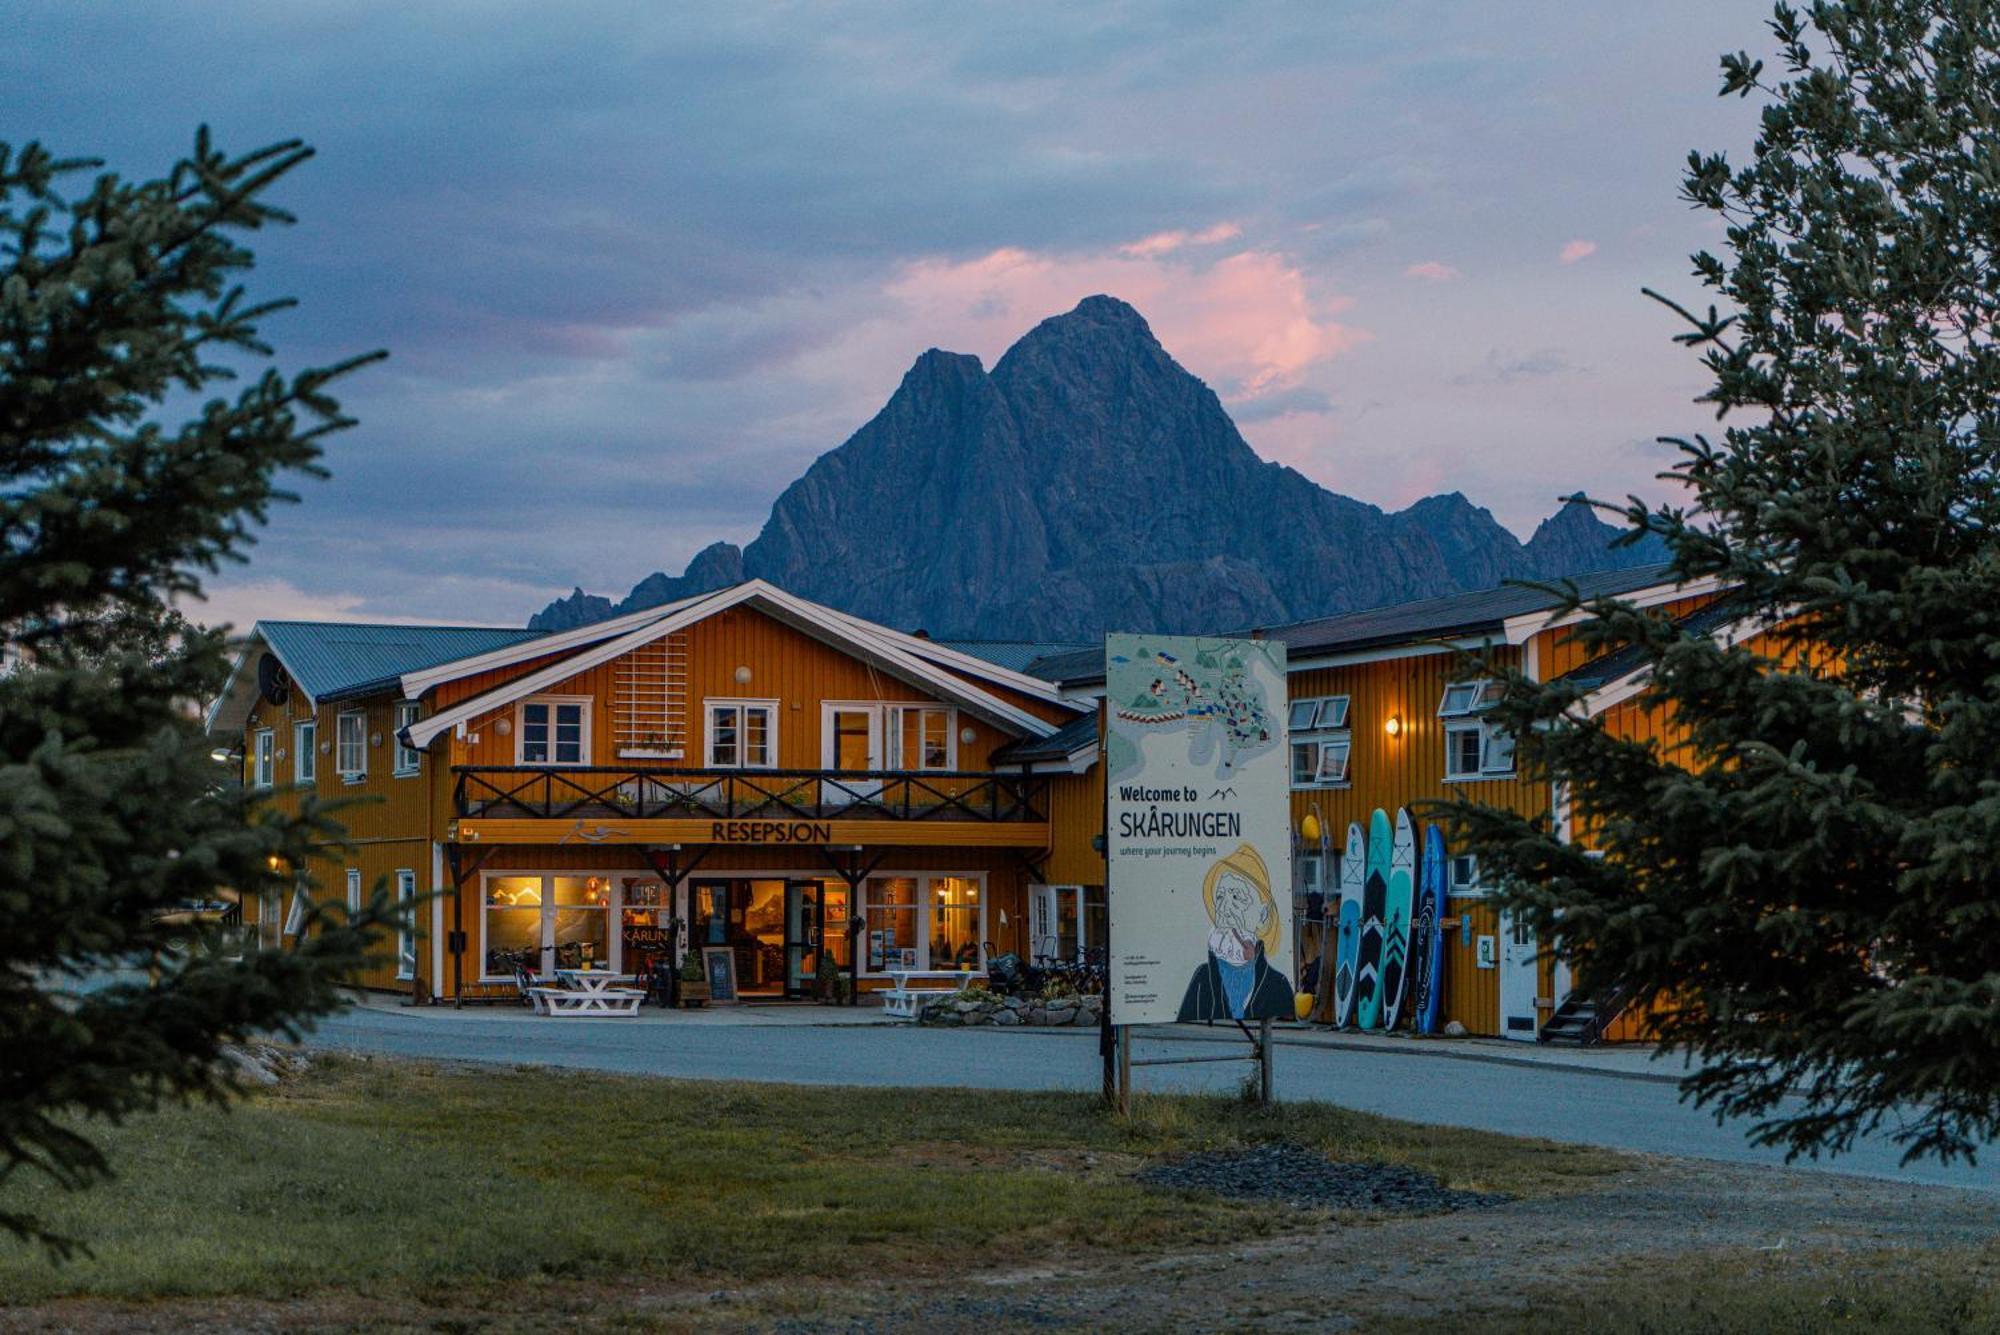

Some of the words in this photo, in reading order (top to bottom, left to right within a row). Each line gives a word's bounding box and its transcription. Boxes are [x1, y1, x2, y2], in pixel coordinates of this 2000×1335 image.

[1120, 786, 1180, 801] Welcome
[1183, 786, 1197, 801] to
[711, 822, 832, 842] RESEPSJON
[1120, 846, 1143, 856] where
[1144, 848, 1161, 858] your
[1163, 846, 1191, 858] journey
[1193, 846, 1216, 858] begins
